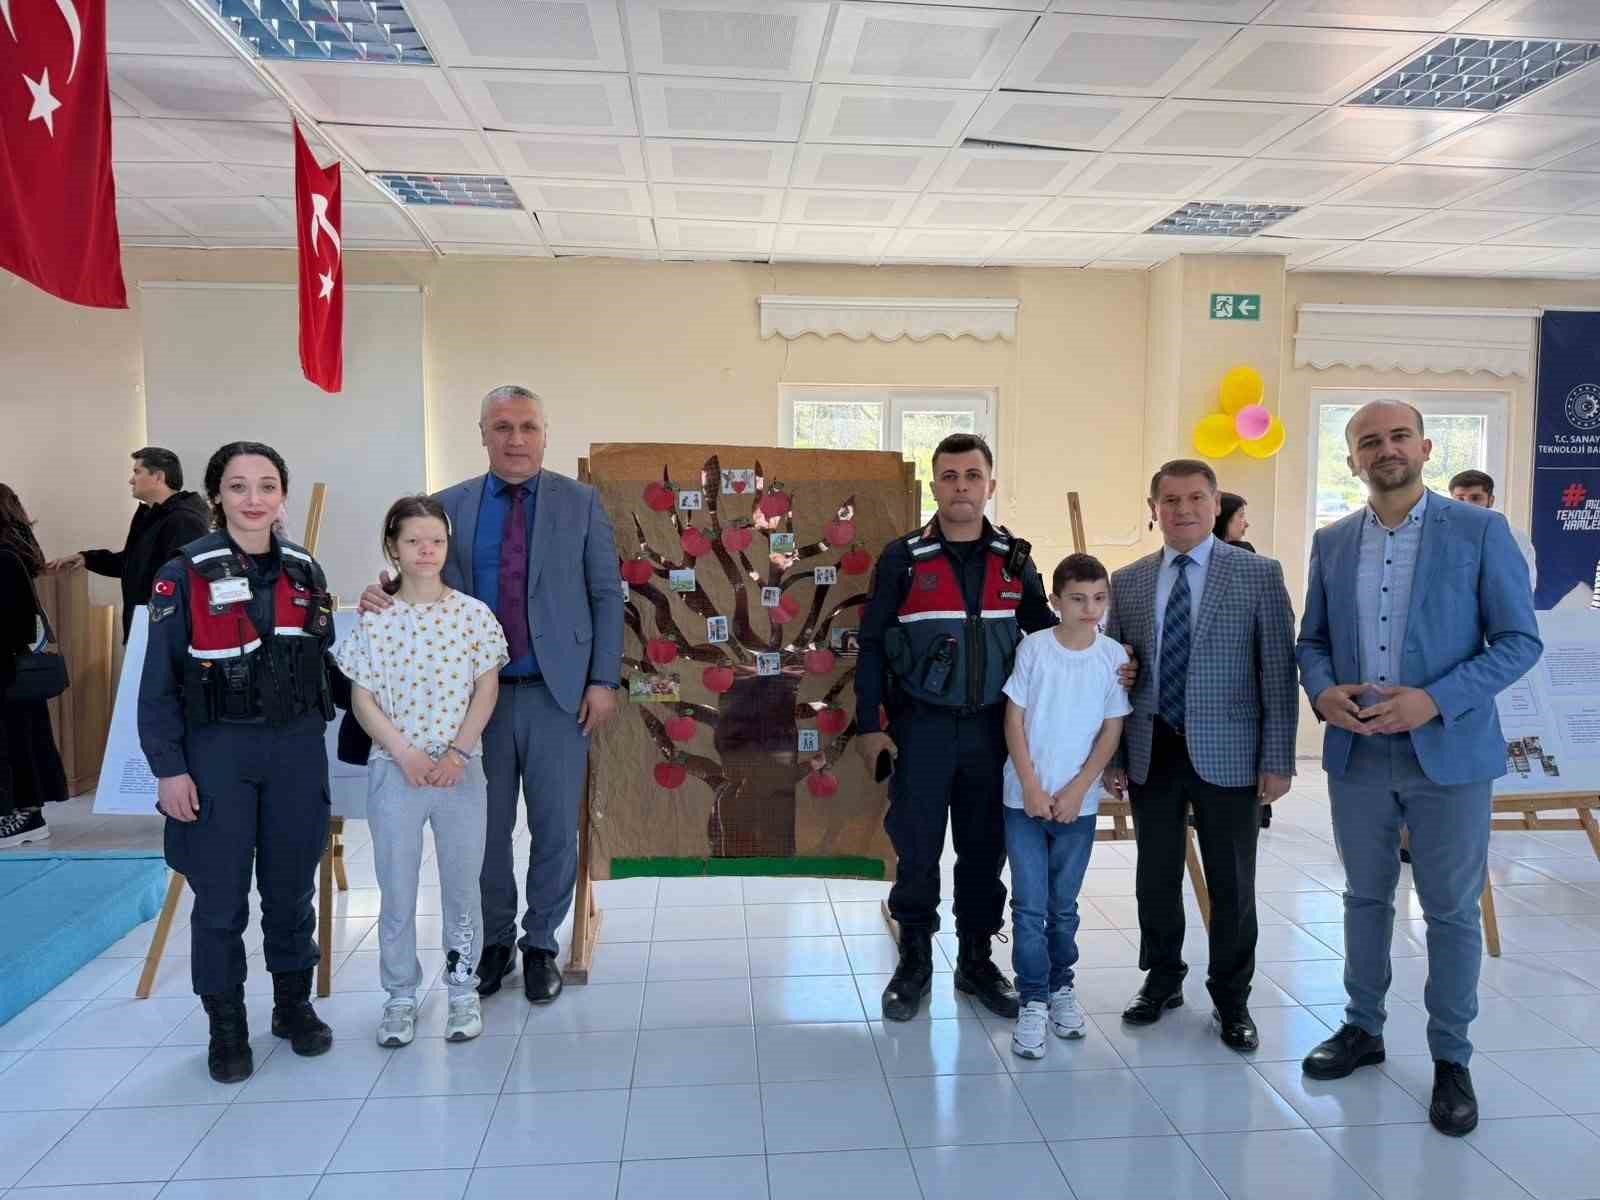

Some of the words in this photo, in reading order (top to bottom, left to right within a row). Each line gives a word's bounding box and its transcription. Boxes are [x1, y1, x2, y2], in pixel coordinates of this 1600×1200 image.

[1554, 434, 1569, 443] T.C.
[1570, 434, 1600, 443] SANAY
[1538, 444, 1585, 454] TEKNOLOJİ
[1587, 445, 1600, 454] BA
